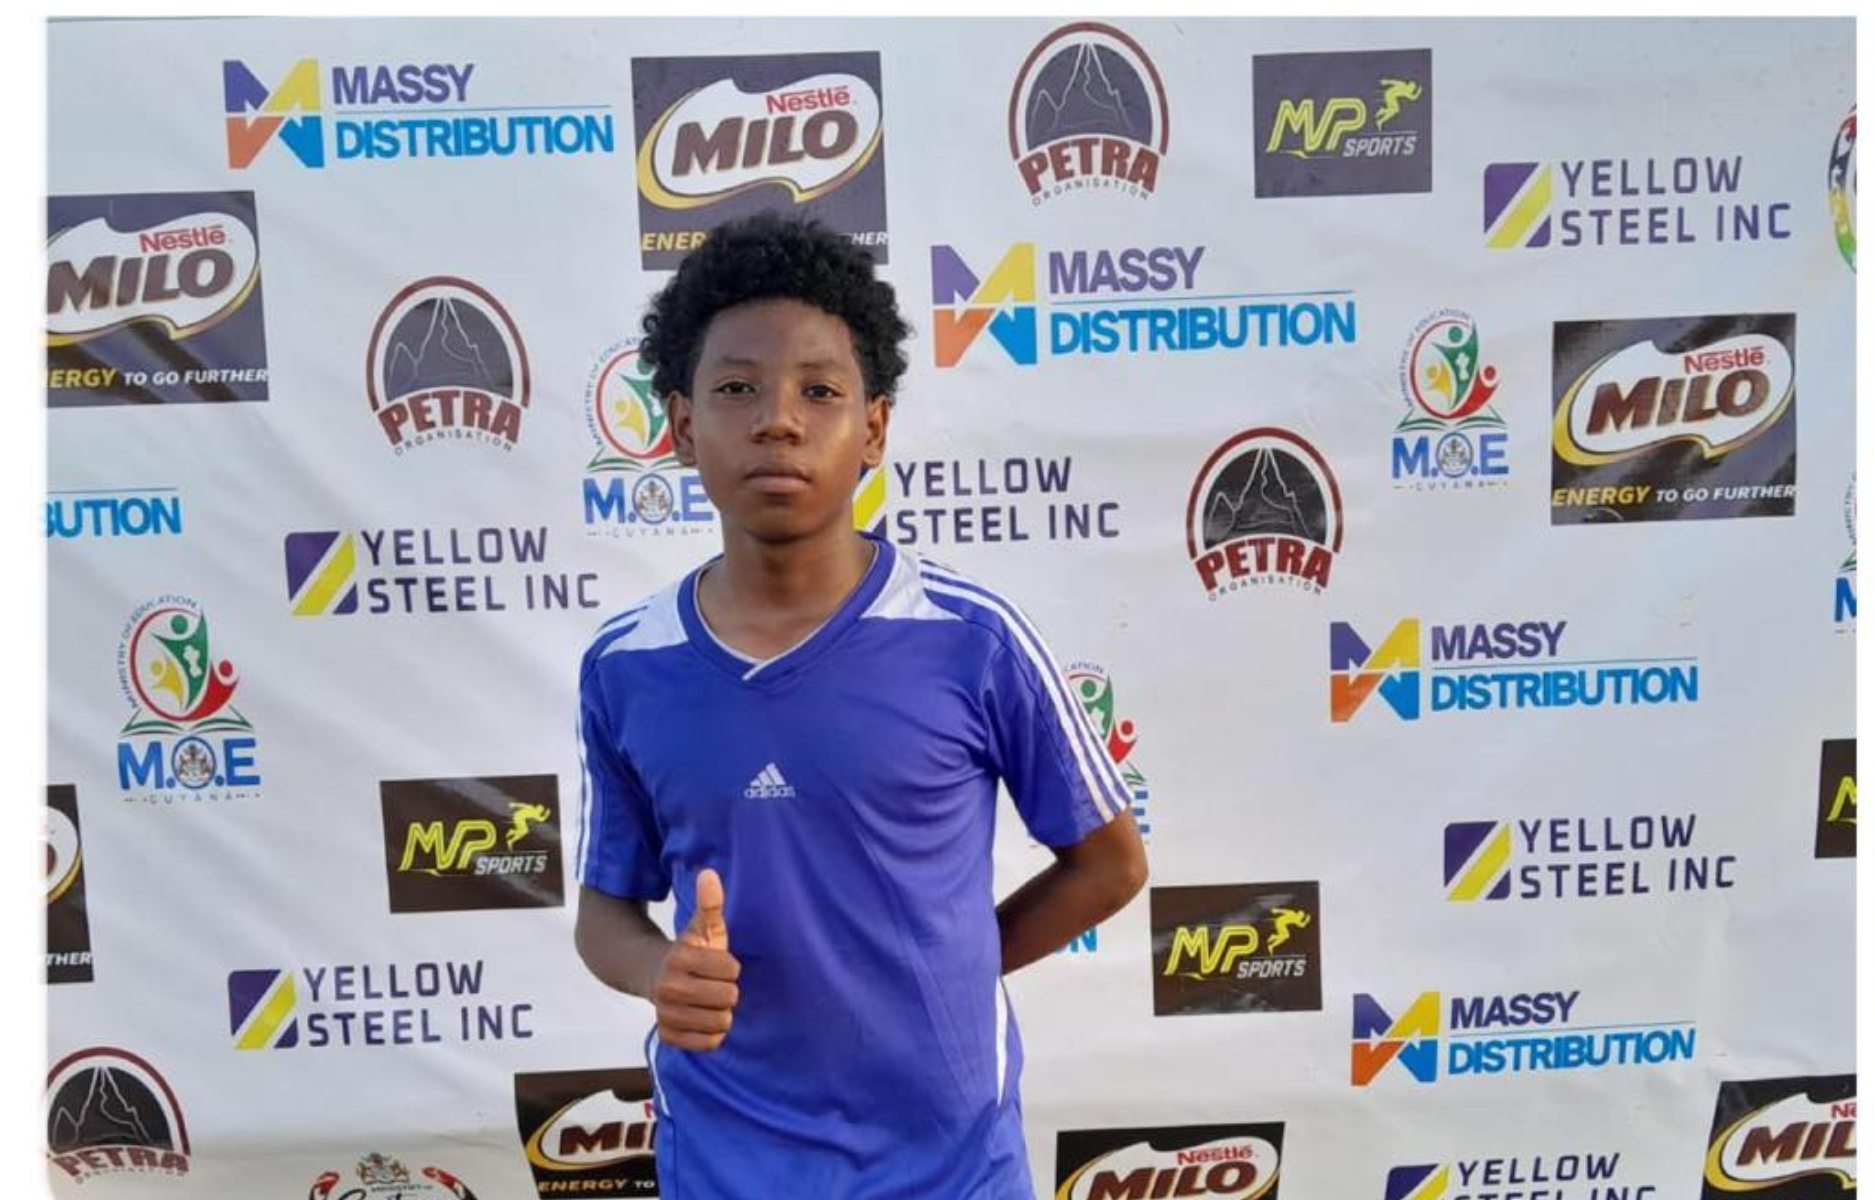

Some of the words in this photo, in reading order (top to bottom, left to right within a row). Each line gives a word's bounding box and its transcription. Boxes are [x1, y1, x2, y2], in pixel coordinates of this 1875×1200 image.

[332, 63, 474, 105] MASSY
[766, 86, 850, 114] Nestlé
[336, 114, 612, 160] DISTRIBUTION
[671, 110, 859, 178] MILO
[1266, 98, 1366, 153] MVP
[1018, 137, 1160, 194] PETRA
[1343, 135, 1418, 158] SPORTS
[1032, 181, 1150, 207] ORGANISATION
[1561, 156, 1742, 198] YELLOW
[140, 224, 225, 253] Nestlé
[643, 232, 706, 252] ENER
[1561, 206, 1696, 247] STEEL
[1716, 203, 1791, 242] INC
[47, 249, 234, 314] MILO
[1050, 246, 1205, 294] MASSY
[1051, 300, 1356, 356] DISTRIBUTION
[46, 367, 116, 389] ERGY
[123, 371, 147, 386] TO
[152, 370, 179, 386] GO
[184, 367, 268, 385] FURTHER
[1684, 346, 1765, 373] Nestlé
[378, 390, 522, 446] PETRA
[1586, 371, 1771, 435] MILO
[395, 427, 512, 455] ORGANISATION
[895, 456, 1071, 498] YELLOW
[1552, 486, 1651, 507] ENERGY
[1656, 488, 1678, 504] TO
[1682, 487, 1709, 503] GO
[1713, 484, 1796, 502] FURTHER
[896, 505, 1029, 545] STEEL
[1050, 503, 1120, 540] INC
[361, 527, 548, 566] YELLOW
[1195, 536, 1334, 590] PETRA
[367, 576, 506, 614] STEEL
[526, 573, 600, 609] INC
[1208, 574, 1322, 602] ORGANISATION
[118, 642, 139, 709] MINISTRY
[131, 595, 199, 623] EDUCATION
[1431, 621, 1566, 661] MASSY
[1432, 666, 1698, 712] DISTRIBUTION
[744, 785, 795, 800] adidas
[400, 821, 496, 873] MVP
[1520, 814, 1696, 854] YELLOW
[475, 855, 547, 876] SPORTS
[1521, 861, 1649, 899] STEEL
[1669, 856, 1736, 891] INC
[1164, 925, 1259, 978] MVP
[1237, 959, 1306, 979] SPORTS
[304, 961, 484, 1001] YELLOW
[307, 1010, 442, 1047] STEEL
[461, 1004, 533, 1040] INC
[1451, 991, 1579, 1029] MASSY
[1449, 1029, 1695, 1075] DISTRIBUTION
[53, 1147, 190, 1179] PETRA
[1086, 1161, 1259, 1200] MILO
[1458, 1153, 1620, 1187] YELLOW
[538, 1180, 628, 1194] ENERGY
[635, 1180, 657, 1191] TO
